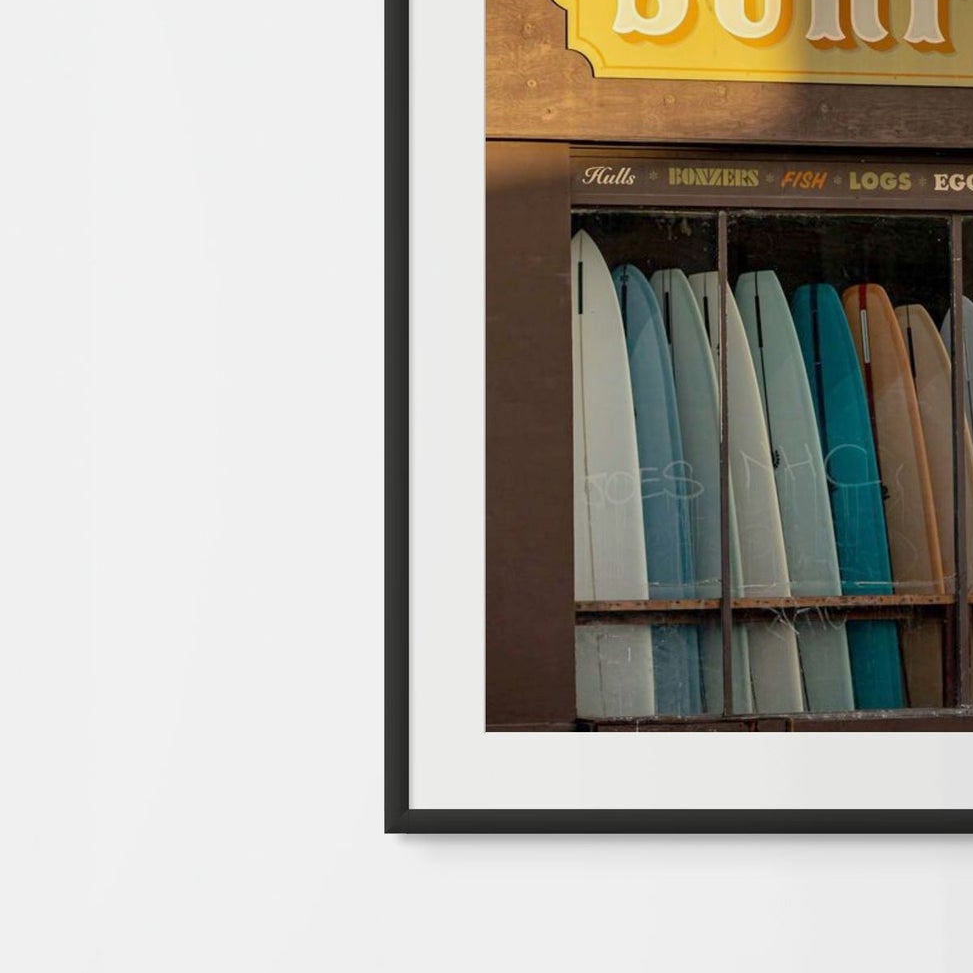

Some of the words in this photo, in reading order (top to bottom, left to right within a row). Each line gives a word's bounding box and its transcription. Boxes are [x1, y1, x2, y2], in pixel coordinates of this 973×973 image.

[582, 165, 636, 186] Hulls
[668, 167, 760, 187] BONZERS
[781, 171, 829, 190] FISH
[849, 172, 912, 191] LOGS
